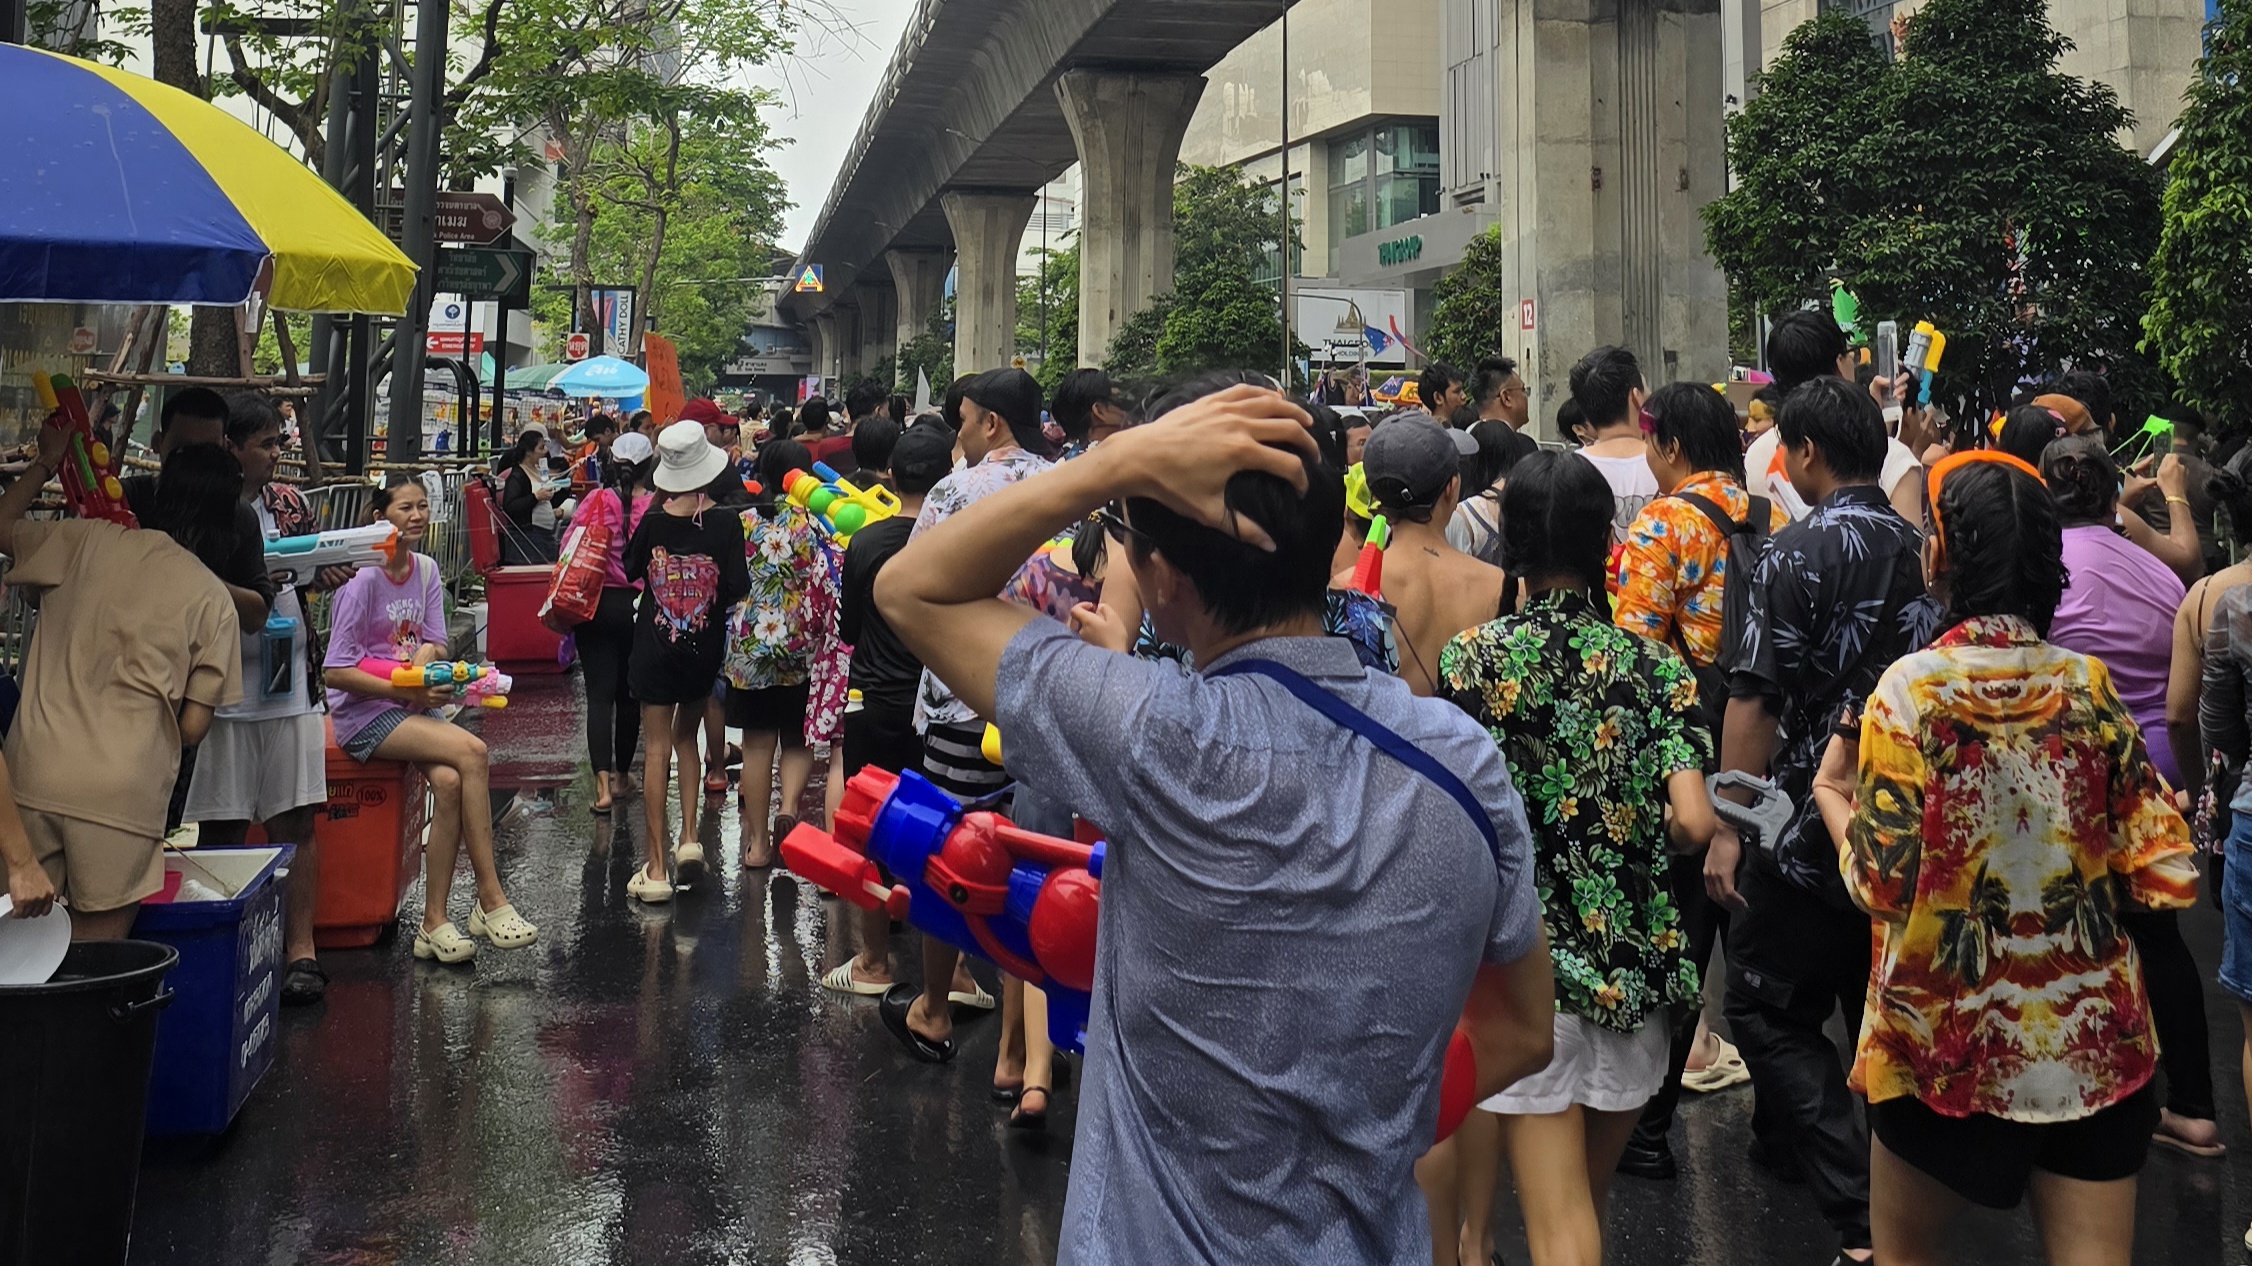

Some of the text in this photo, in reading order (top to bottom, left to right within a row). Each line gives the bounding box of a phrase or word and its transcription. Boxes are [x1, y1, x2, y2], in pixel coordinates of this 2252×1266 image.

[1523, 303, 1533, 325] 12
[617, 294, 629, 354] CATHY DOLL
[568, 341, 588, 355] หยุด
[661, 585, 703, 598] DESIGN
[360, 789, 383, 799] 100%
